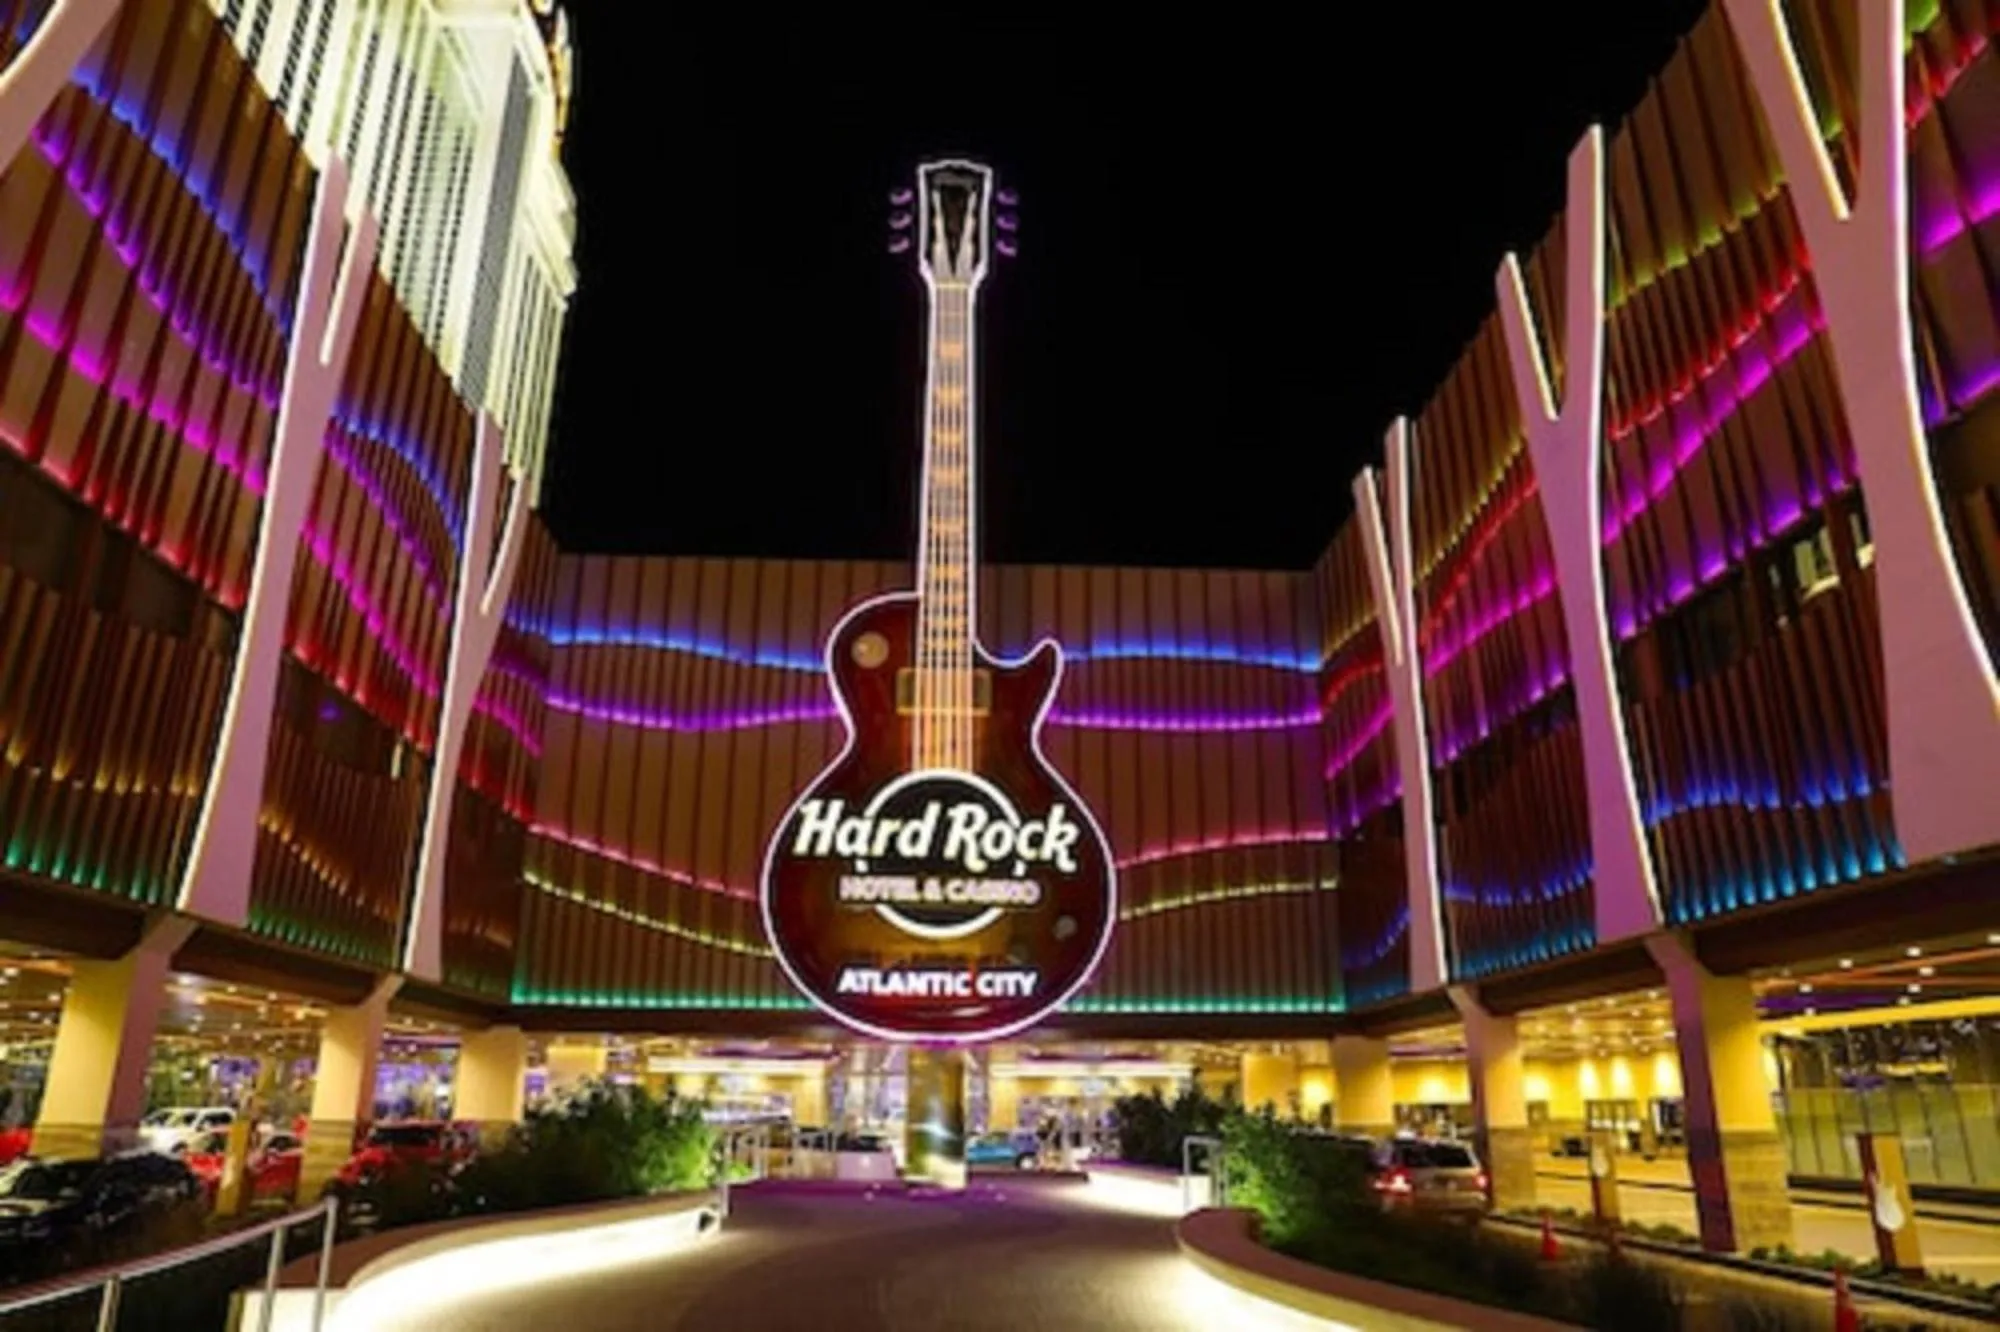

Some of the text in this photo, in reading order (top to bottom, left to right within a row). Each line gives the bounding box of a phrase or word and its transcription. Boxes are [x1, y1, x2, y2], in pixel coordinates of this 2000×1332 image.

[793, 799, 1078, 872] Hard Rock
[839, 875, 1041, 904] HOTEL & CASINO
[838, 969, 1037, 996] ATLANTIC CITY
